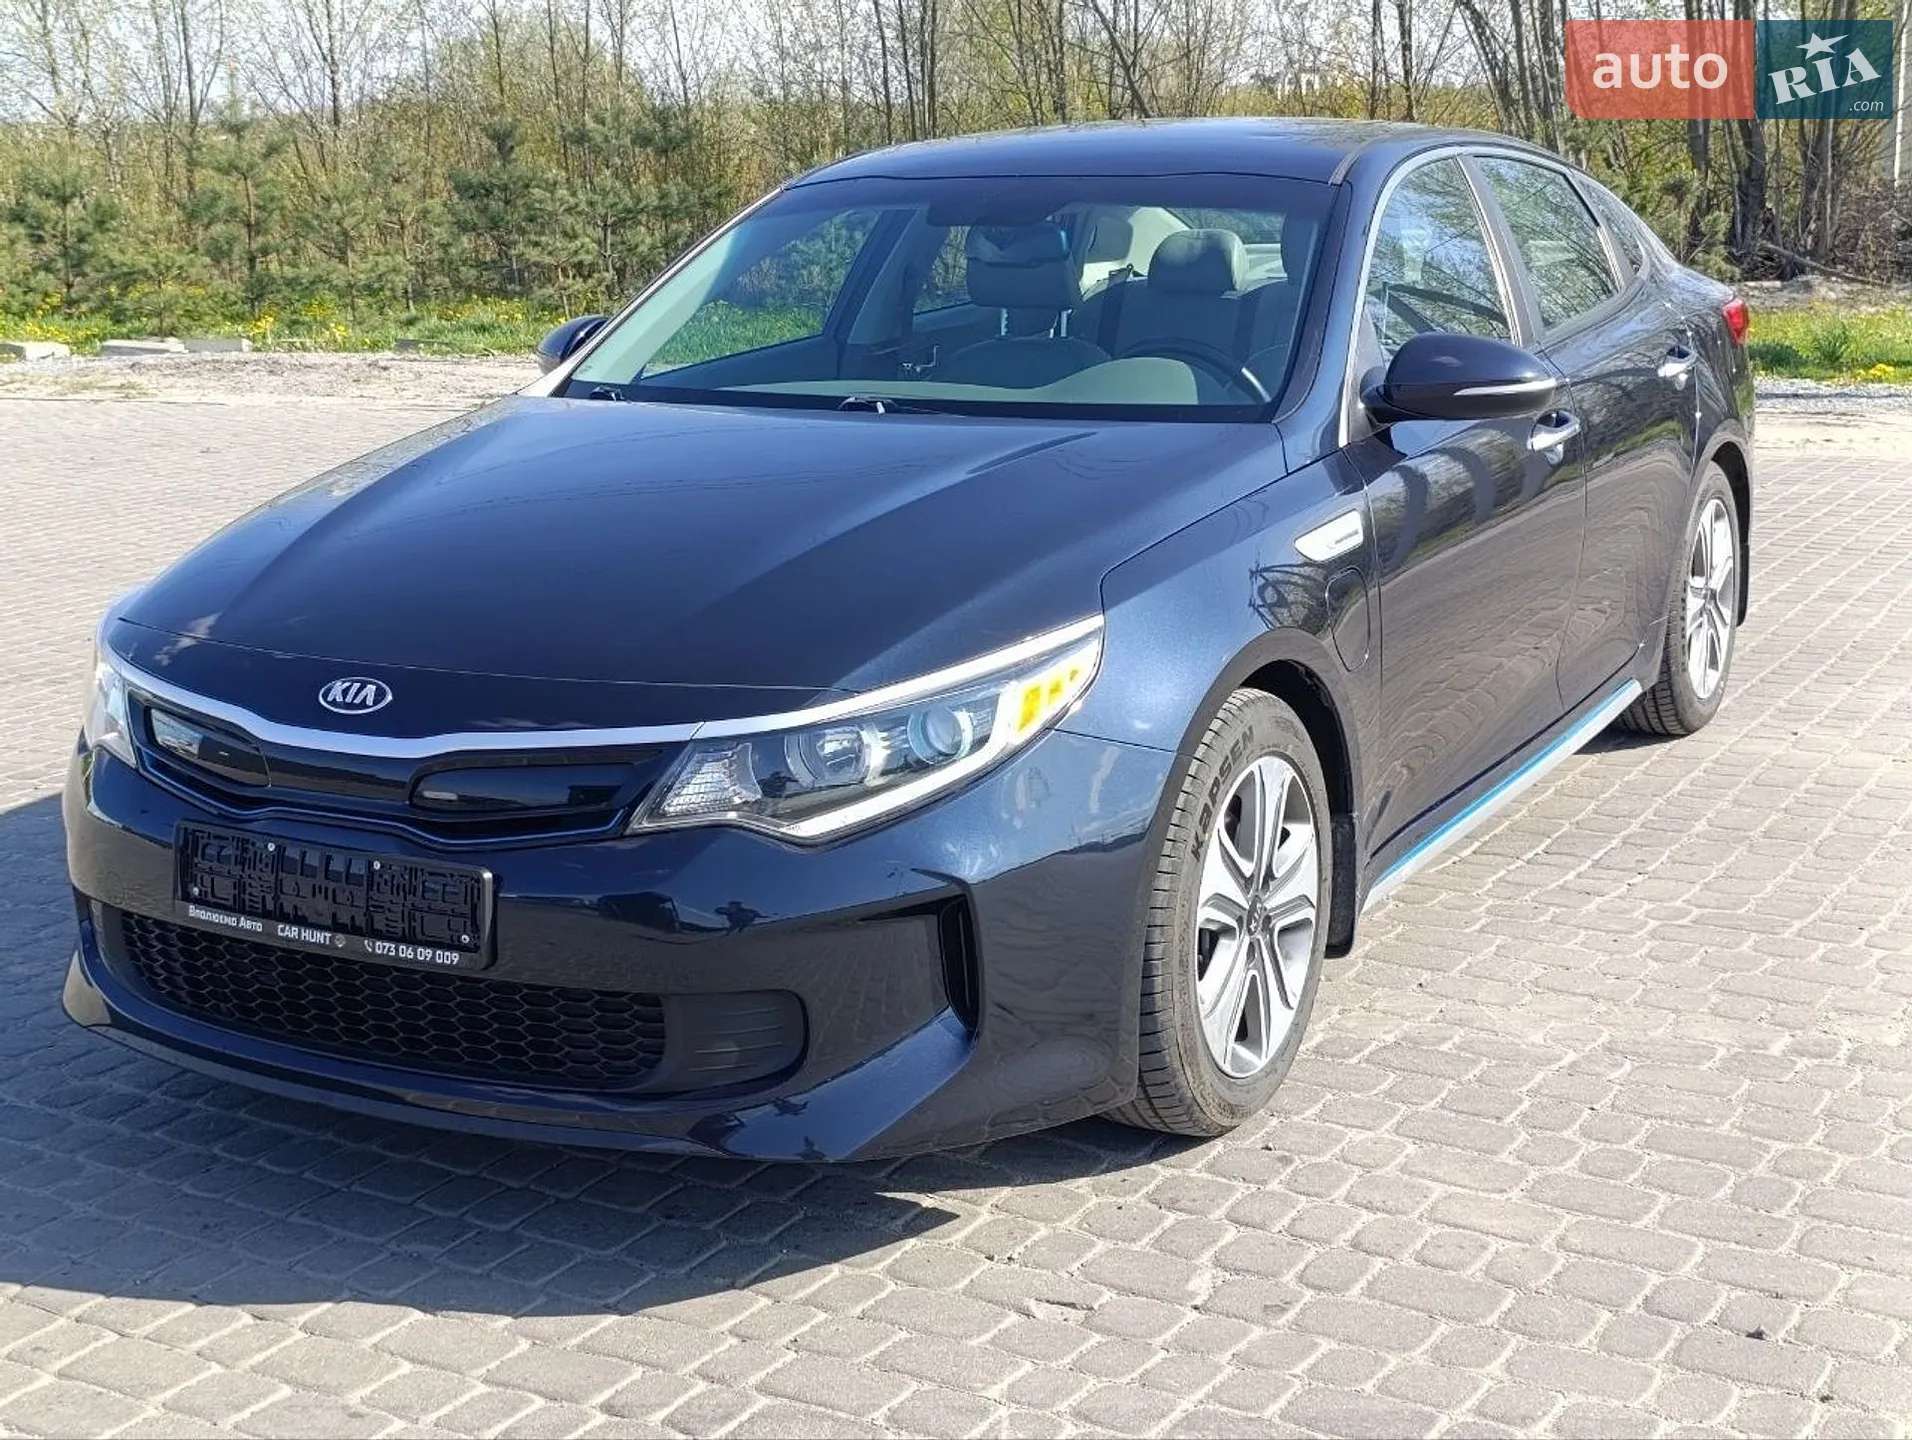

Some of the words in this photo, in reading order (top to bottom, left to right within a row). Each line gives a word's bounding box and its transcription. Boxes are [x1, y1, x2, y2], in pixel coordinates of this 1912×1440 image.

[327, 681, 376, 706] KIA
[239, 916, 263, 932] Авто
[277, 924, 299, 939] CAR
[301, 929, 332, 945] HUNT
[375, 941, 396, 956] 073
[399, 945, 414, 959] 06
[416, 948, 432, 960] 09
[435, 950, 460, 965] 009
